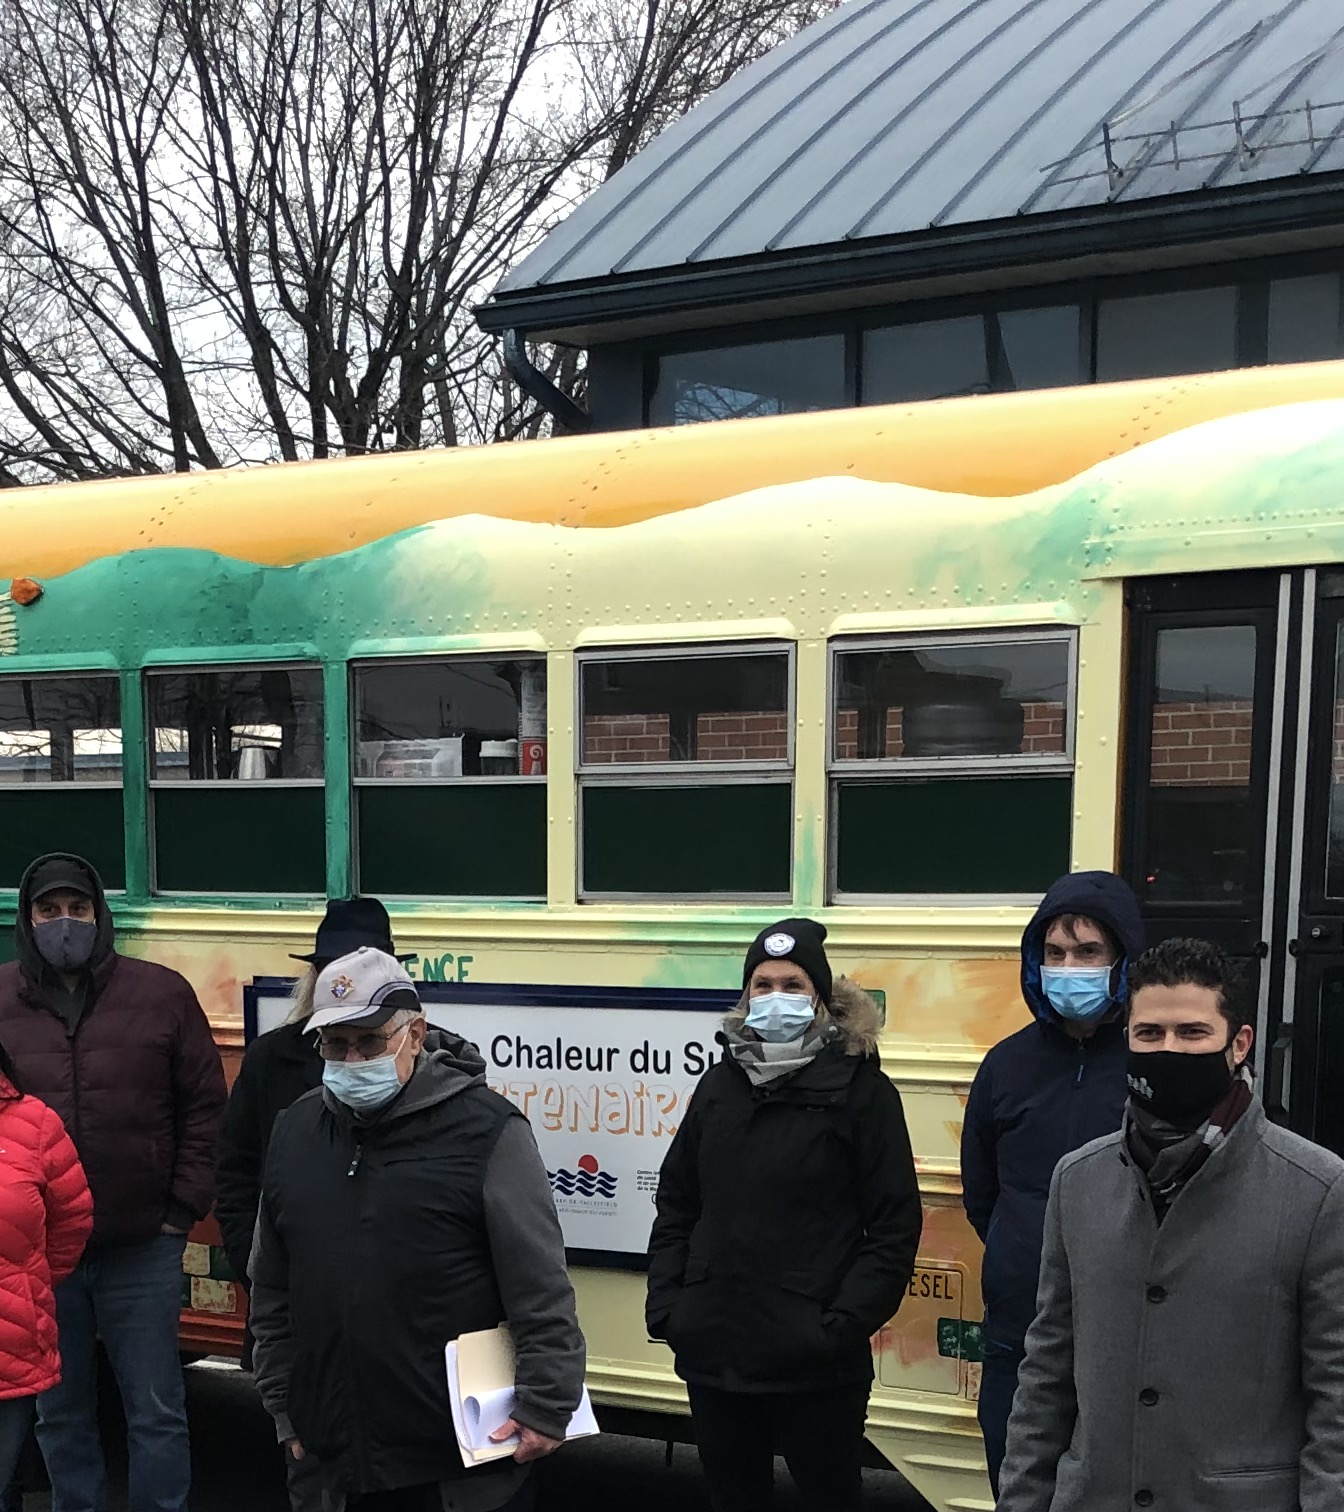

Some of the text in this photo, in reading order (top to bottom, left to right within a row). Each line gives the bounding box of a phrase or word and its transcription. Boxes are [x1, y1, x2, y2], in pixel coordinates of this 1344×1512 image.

[491, 1035, 726, 1076] Chaleur du Su
[909, 1273, 954, 1300] ESEL
